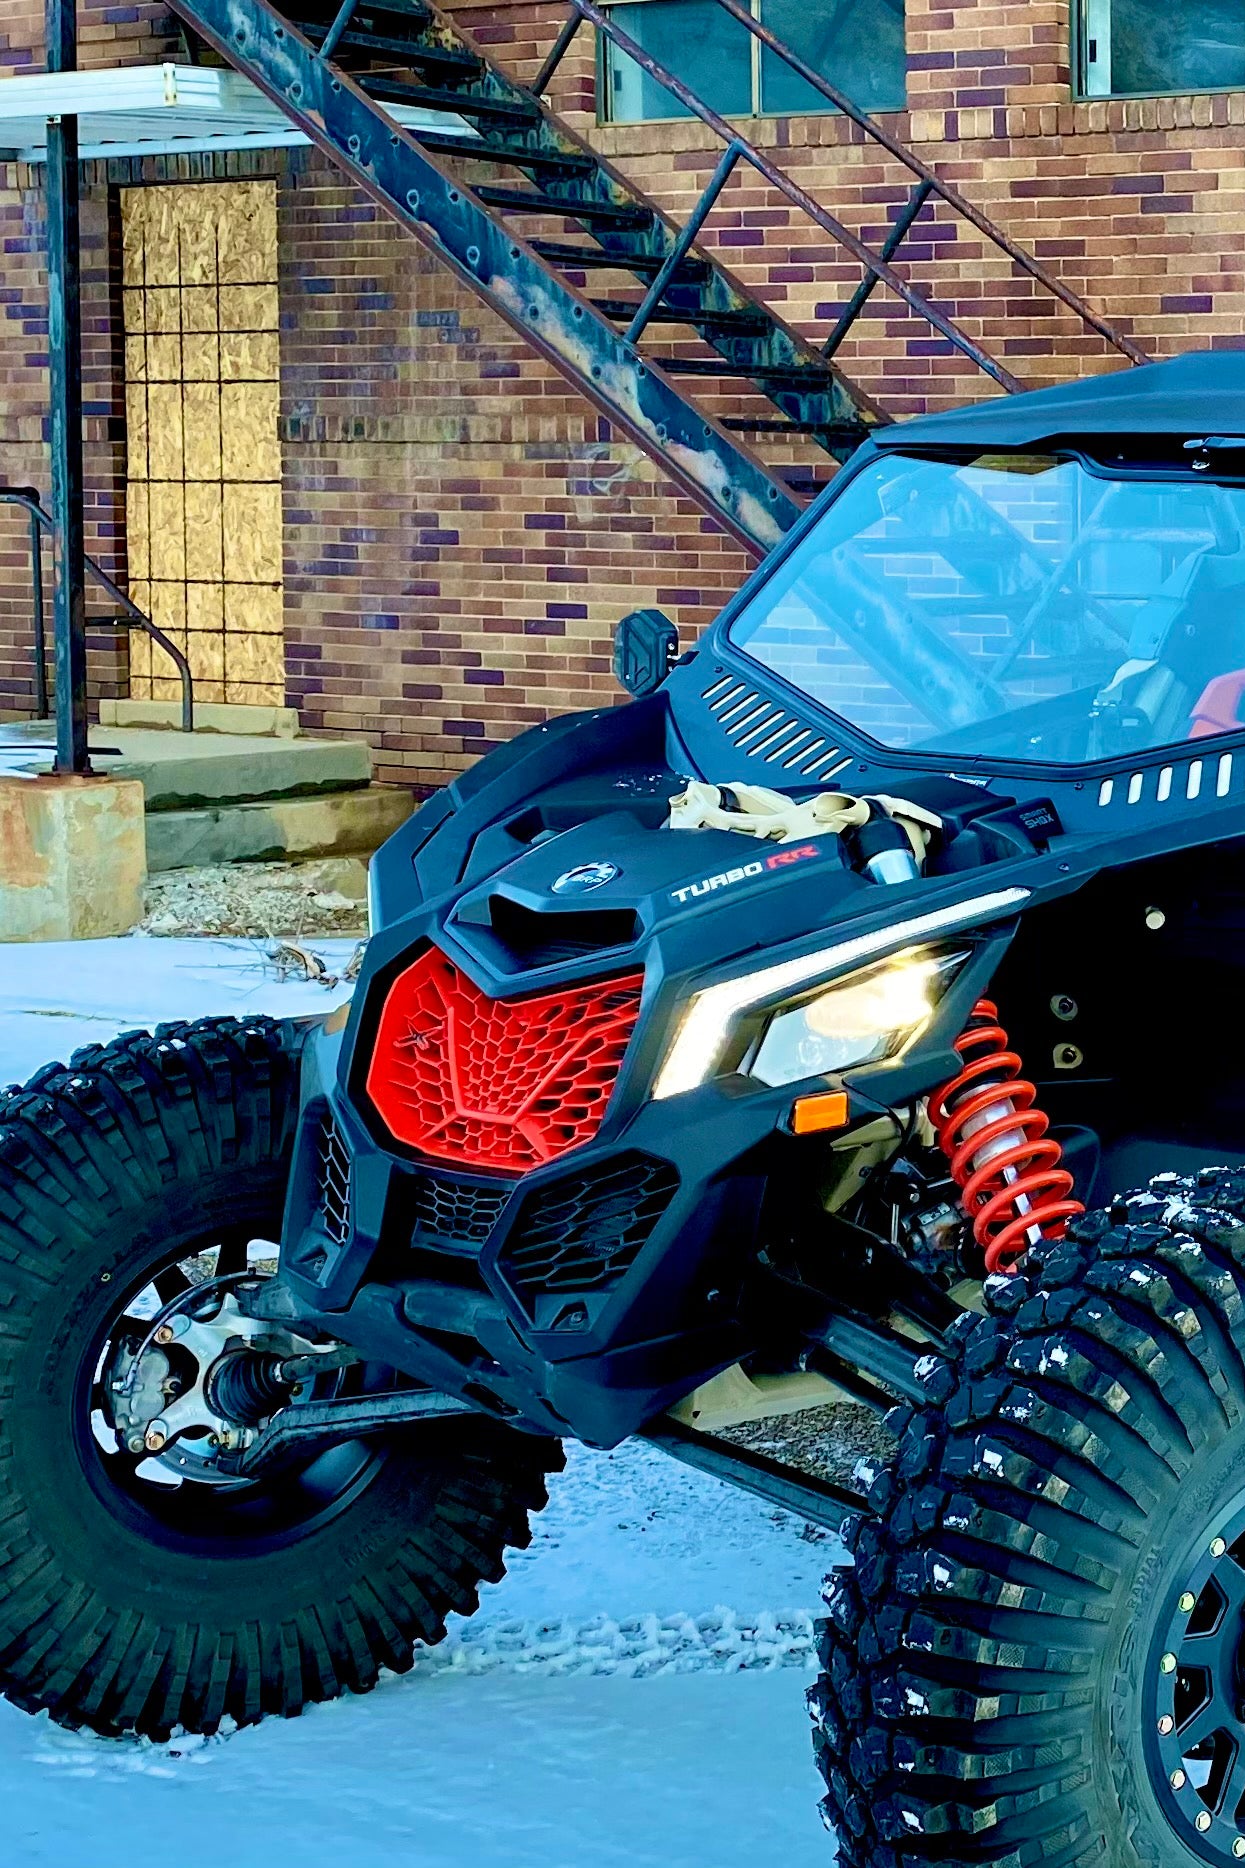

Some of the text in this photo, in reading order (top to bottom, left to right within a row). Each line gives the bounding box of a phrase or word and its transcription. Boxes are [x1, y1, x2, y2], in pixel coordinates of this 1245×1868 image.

[1024, 813, 1055, 829] SHOX
[671, 844, 821, 903] TURBO RR
